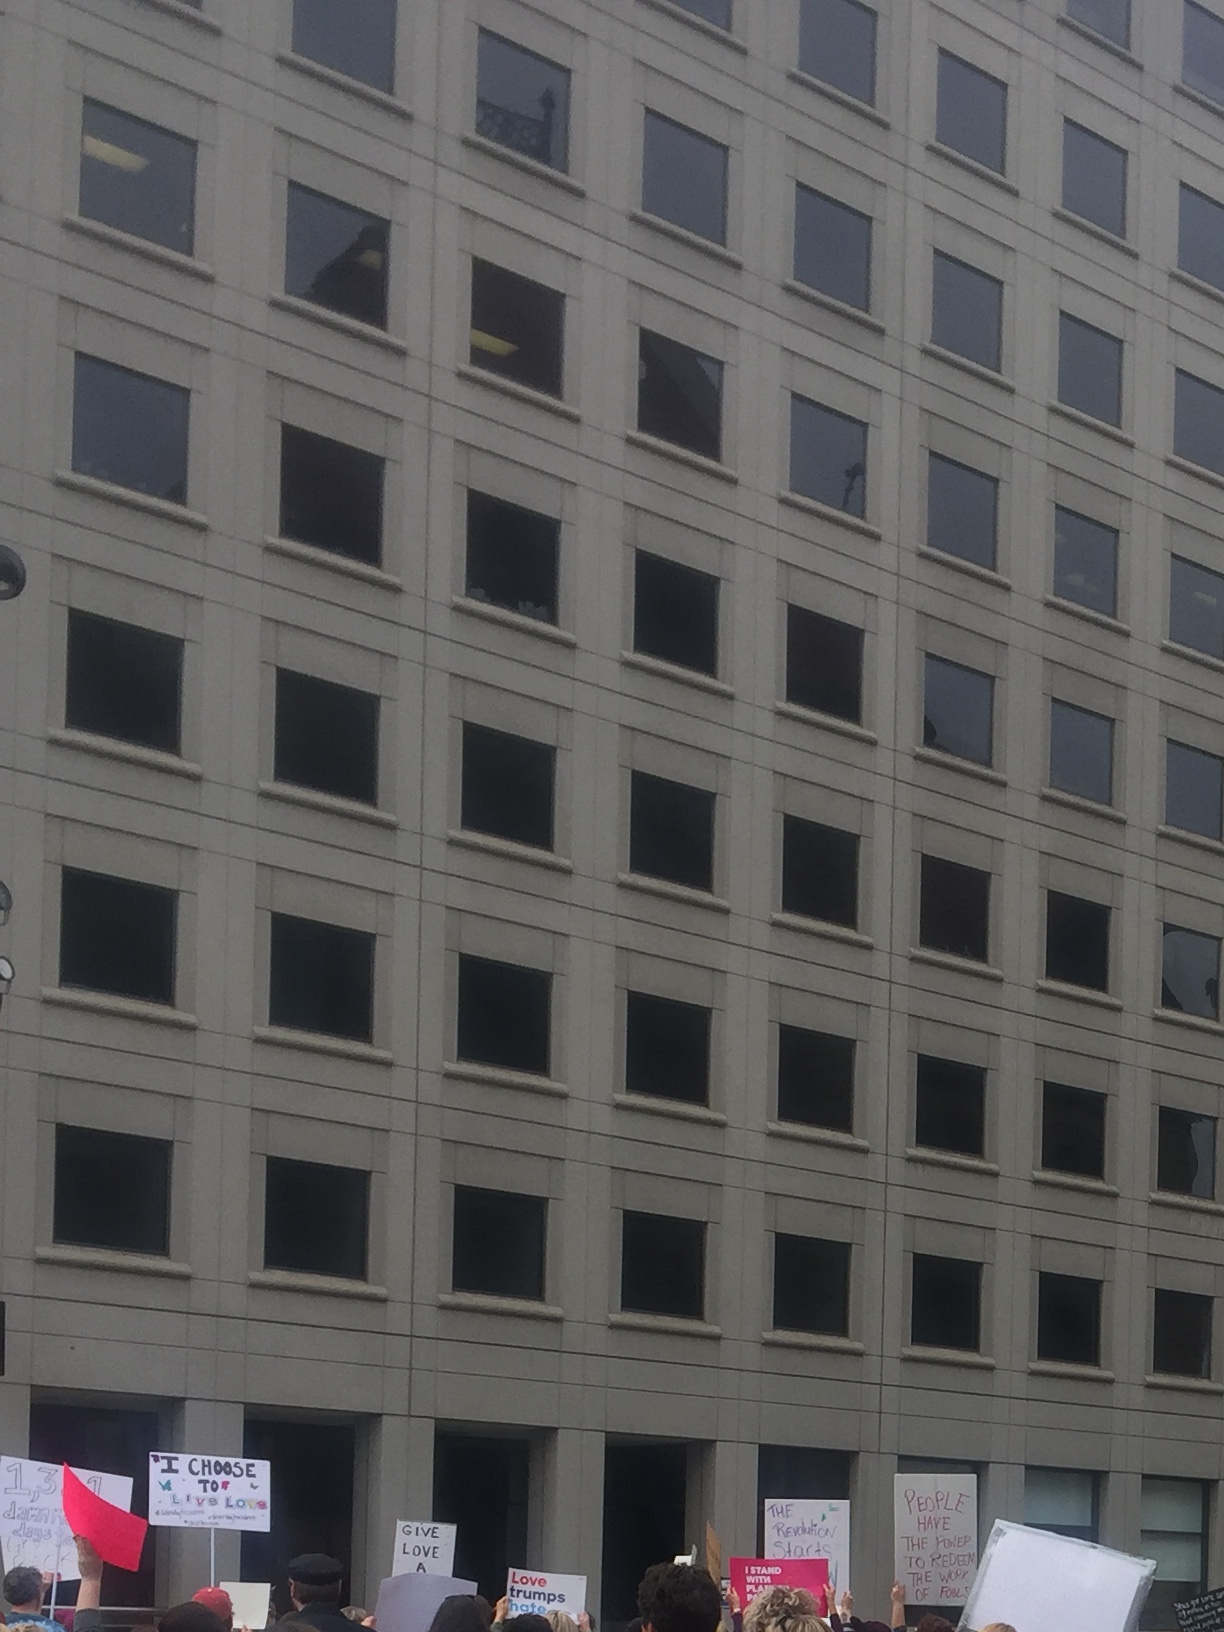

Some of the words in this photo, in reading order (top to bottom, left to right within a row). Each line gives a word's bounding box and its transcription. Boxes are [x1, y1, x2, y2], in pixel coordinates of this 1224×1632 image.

[160, 1455, 179, 1474] I
[188, 1457, 257, 1478] CHOOSE
[4, 1462, 103, 1503] 1,31
[197, 1479, 219, 1493] TO
[904, 1488, 971, 1515] PEOPLE
[766, 1503, 794, 1518] THE
[402, 1524, 440, 1539] GIVE
[917, 1516, 951, 1532] HAVE
[402, 1542, 440, 1558] LOVE
[772, 1541, 832, 1560] Starts
[901, 1536, 929, 1551] THE
[935, 1535, 971, 1550] POWER
[416, 1562, 427, 1573] A
[903, 1555, 926, 1569] TO
[930, 1551, 976, 1568] REDEEM
[744, 1565, 749, 1575] I
[750, 1565, 782, 1575] STAND
[907, 1570, 932, 1587] THE
[940, 1568, 969, 1585] WORK
[511, 1571, 548, 1588] Love
[746, 1575, 771, 1584] WITH
[509, 1585, 567, 1605] trumps
[915, 1586, 931, 1602] OF
[508, 1598, 547, 1615] hate
